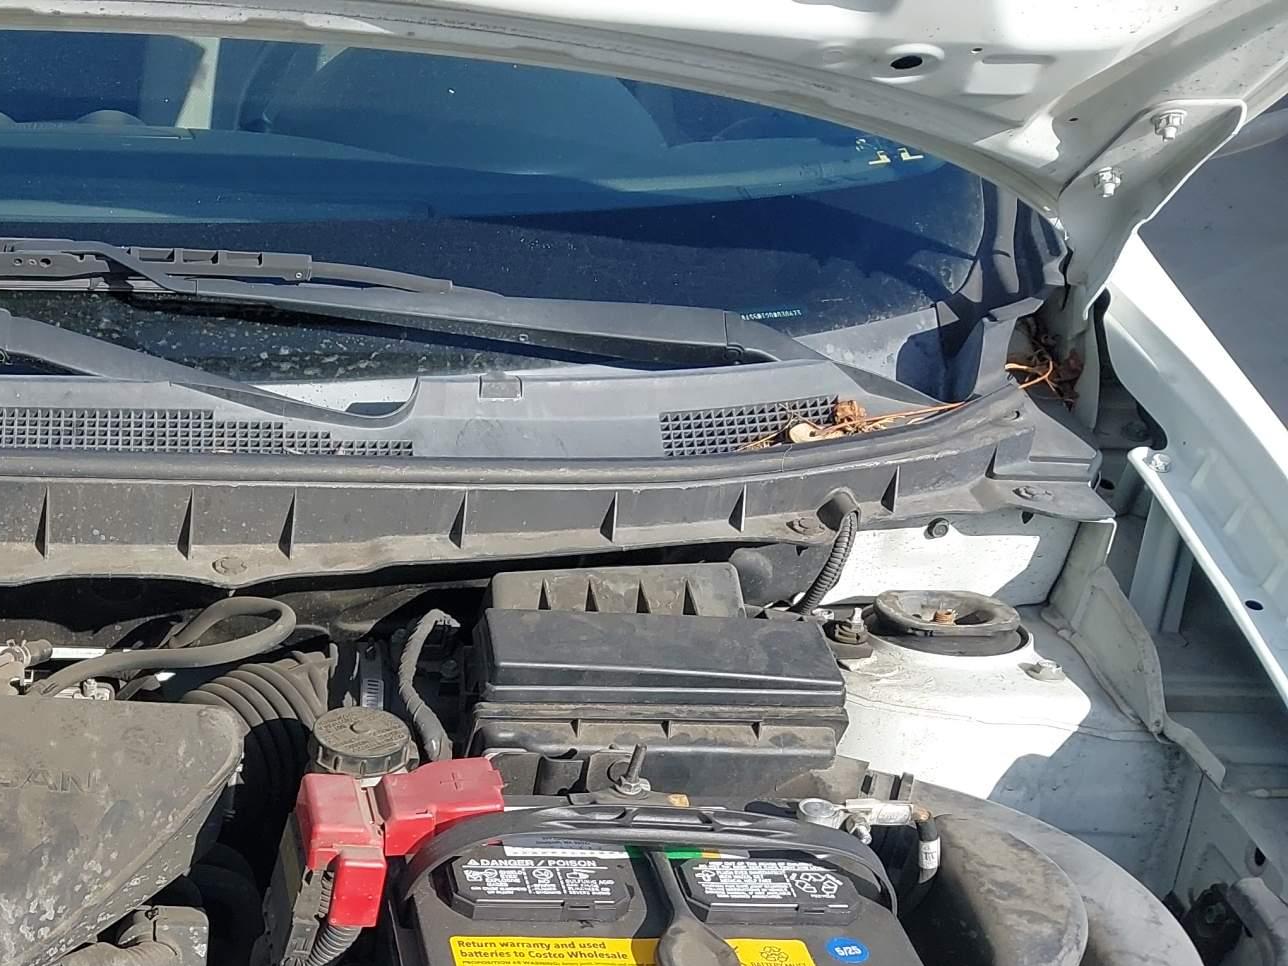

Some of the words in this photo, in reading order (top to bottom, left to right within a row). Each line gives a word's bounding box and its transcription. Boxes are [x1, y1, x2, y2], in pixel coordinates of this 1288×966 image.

[480, 859, 535, 867] DANGER
[547, 859, 597, 867] POISON
[457, 940, 496, 948] Return
[500, 942, 551, 950] warranty
[554, 941, 575, 949] and
[581, 941, 606, 949] used
[460, 950, 511, 958] batteries
[528, 950, 565, 959] Costco
[568, 951, 628, 959] Wholesale
